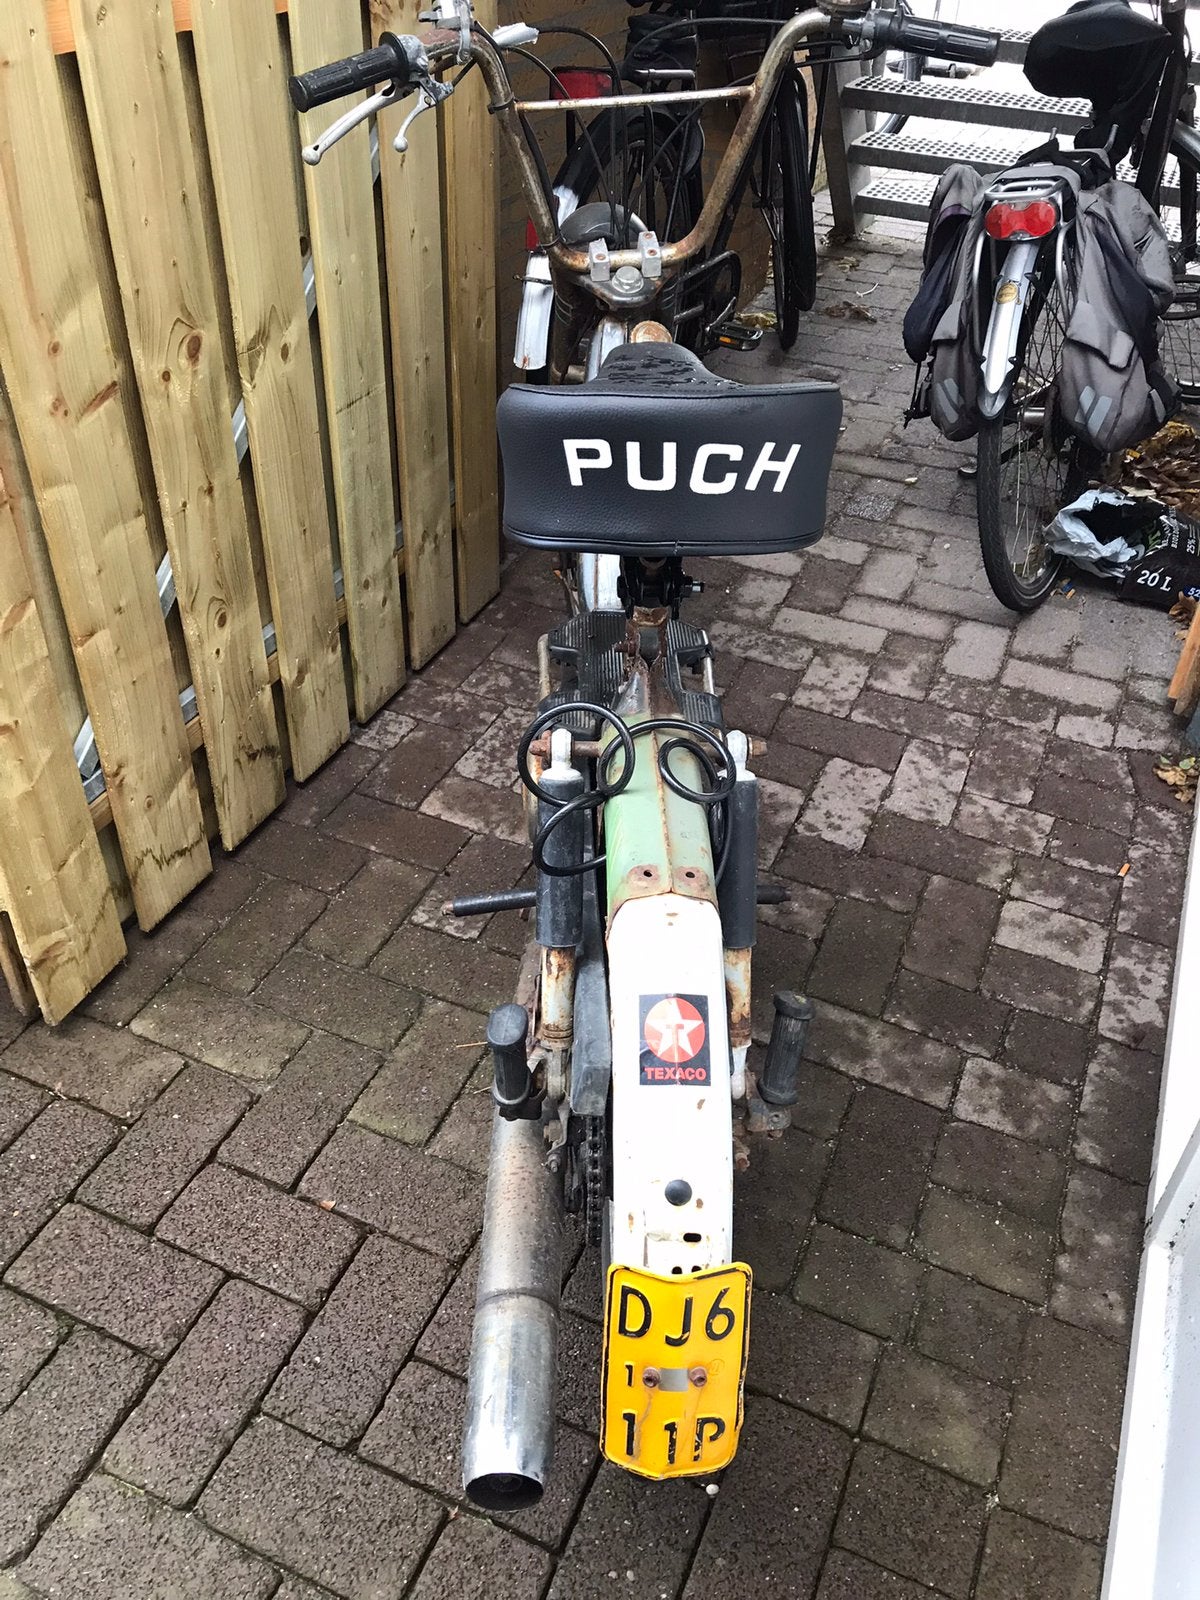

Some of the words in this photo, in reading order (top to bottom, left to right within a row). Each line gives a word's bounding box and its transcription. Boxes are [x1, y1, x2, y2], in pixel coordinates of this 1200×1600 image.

[562, 438, 801, 495] PUCH
[1136, 569, 1160, 588] 20
[1159, 576, 1172, 592] L
[644, 1066, 707, 1081] TEXACO
[624, 1364, 635, 1387] 1
[622, 1412, 726, 1465] 11P
